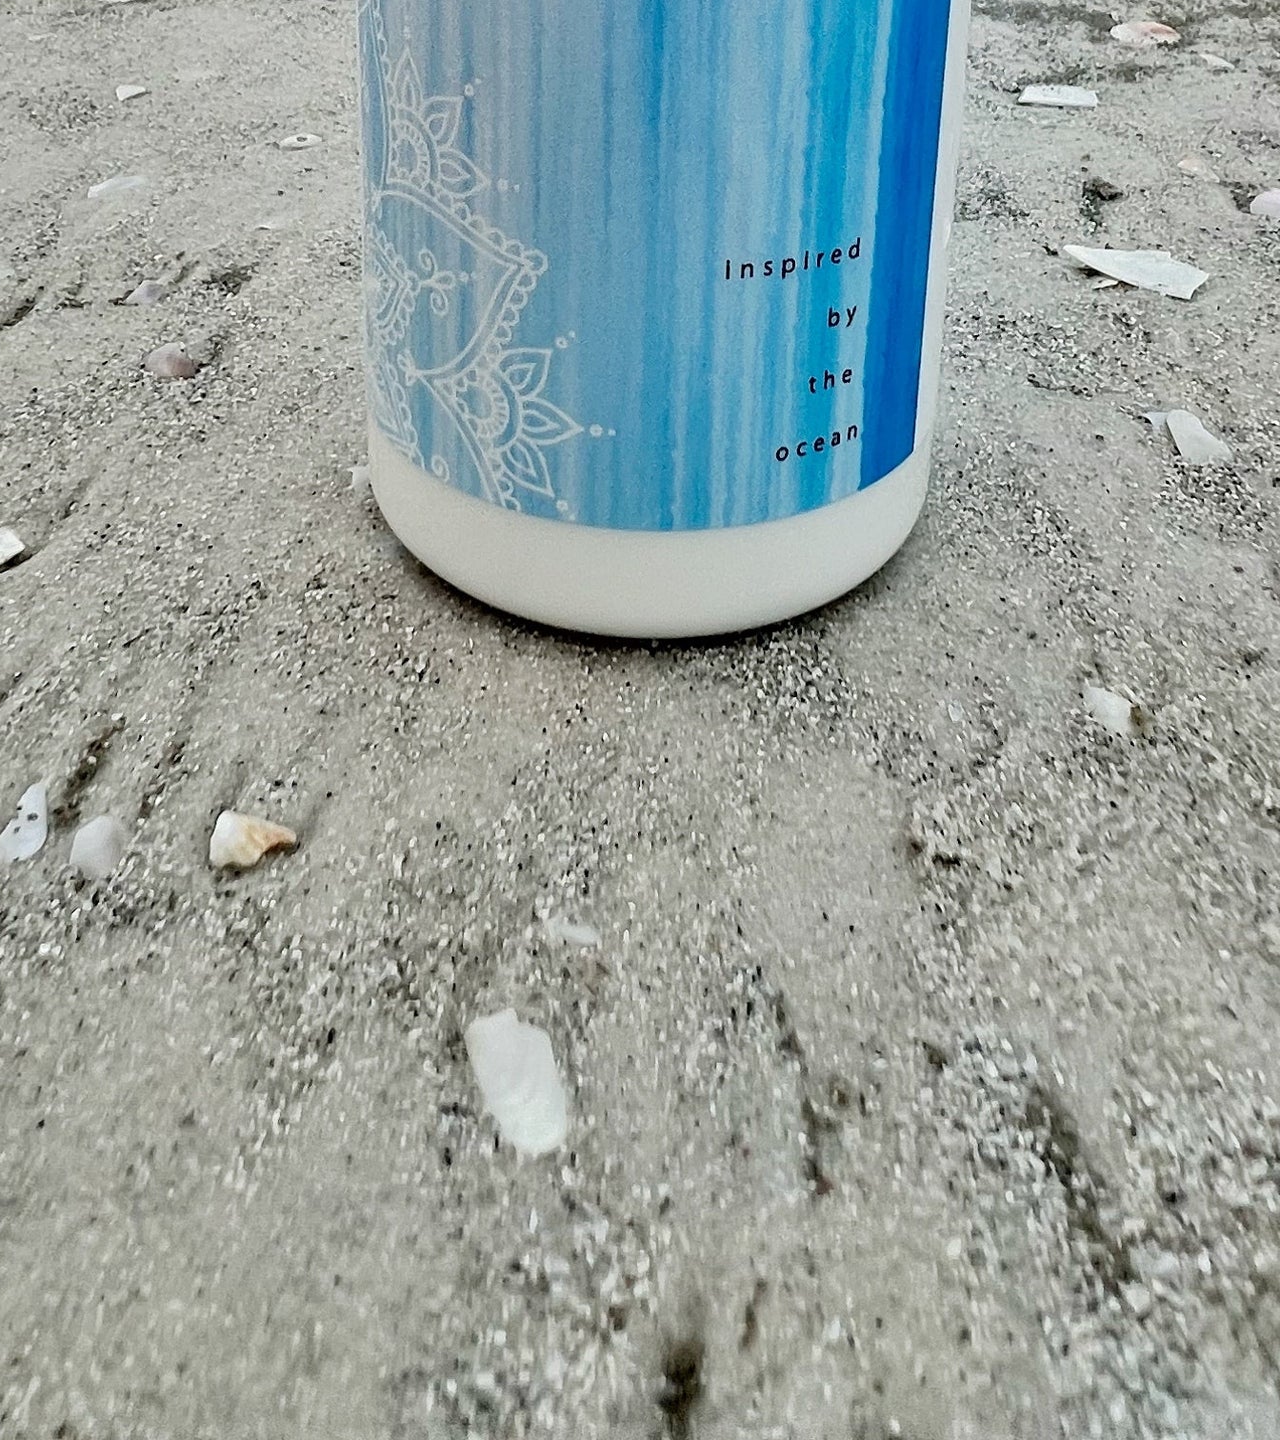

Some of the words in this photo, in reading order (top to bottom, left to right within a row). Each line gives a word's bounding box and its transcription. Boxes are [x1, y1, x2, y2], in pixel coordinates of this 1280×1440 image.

[827, 306, 857, 328] by
[808, 367, 853, 393] the
[775, 424, 858, 461] ocean
